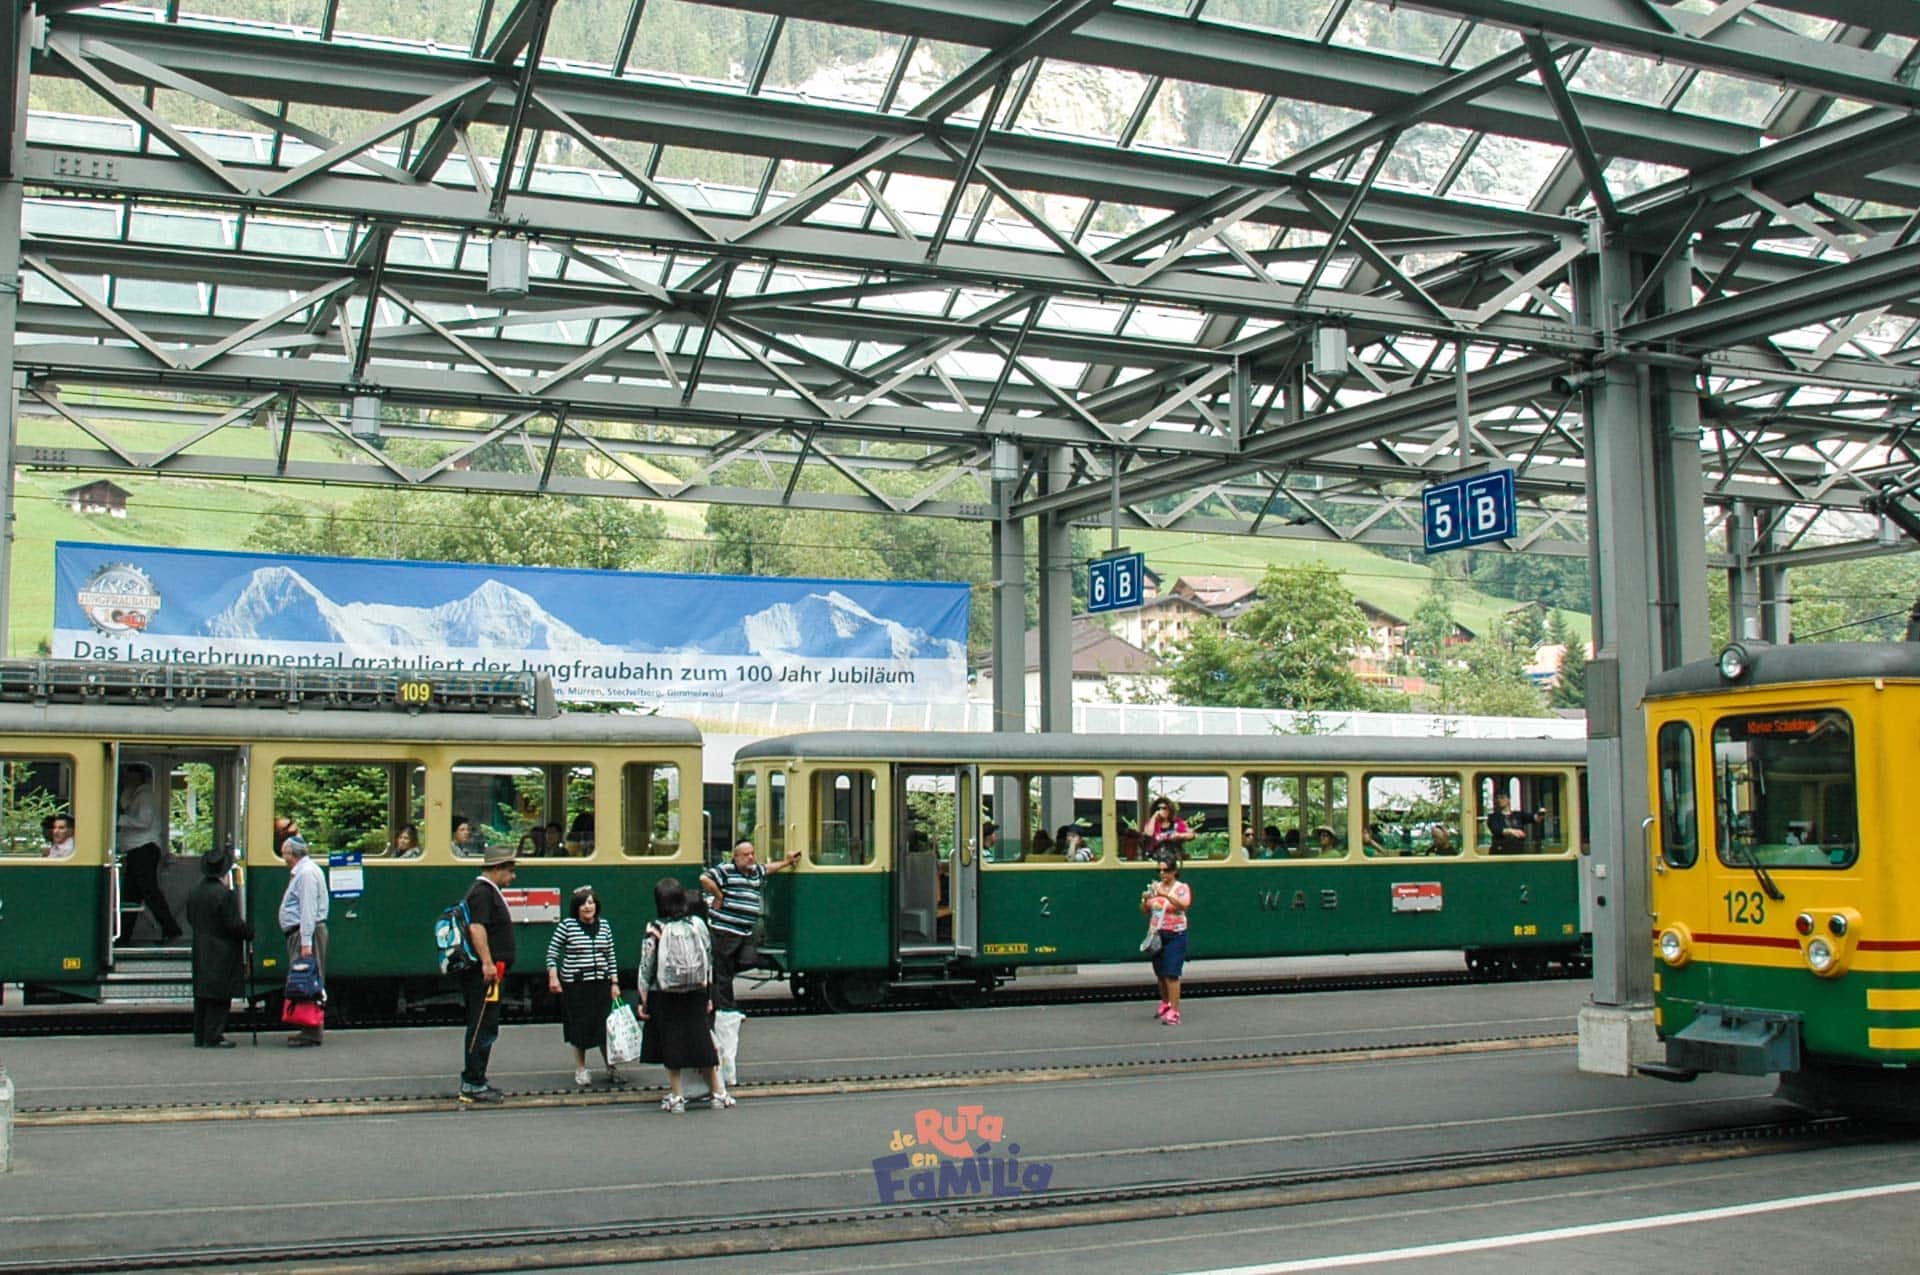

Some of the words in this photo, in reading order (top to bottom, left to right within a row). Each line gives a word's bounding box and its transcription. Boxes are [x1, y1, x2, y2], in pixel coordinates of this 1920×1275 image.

[1435, 504, 1452, 538] 5
[1477, 496, 1497, 531] B
[1094, 575, 1105, 602] 6
[1119, 571, 1131, 598] B
[74, 640, 119, 660] Das
[128, 643, 342, 669] Lauterbrunnental
[473, 658, 511, 673] der
[521, 658, 673, 682] Jungfraubahn
[680, 667, 727, 681] zum
[737, 665, 772, 682] 100
[779, 665, 822, 683] Jahr
[829, 666, 915, 684] Jubiläum
[400, 682, 430, 701] 109
[1039, 896, 1051, 917] 2
[1723, 889, 1765, 925] 123
